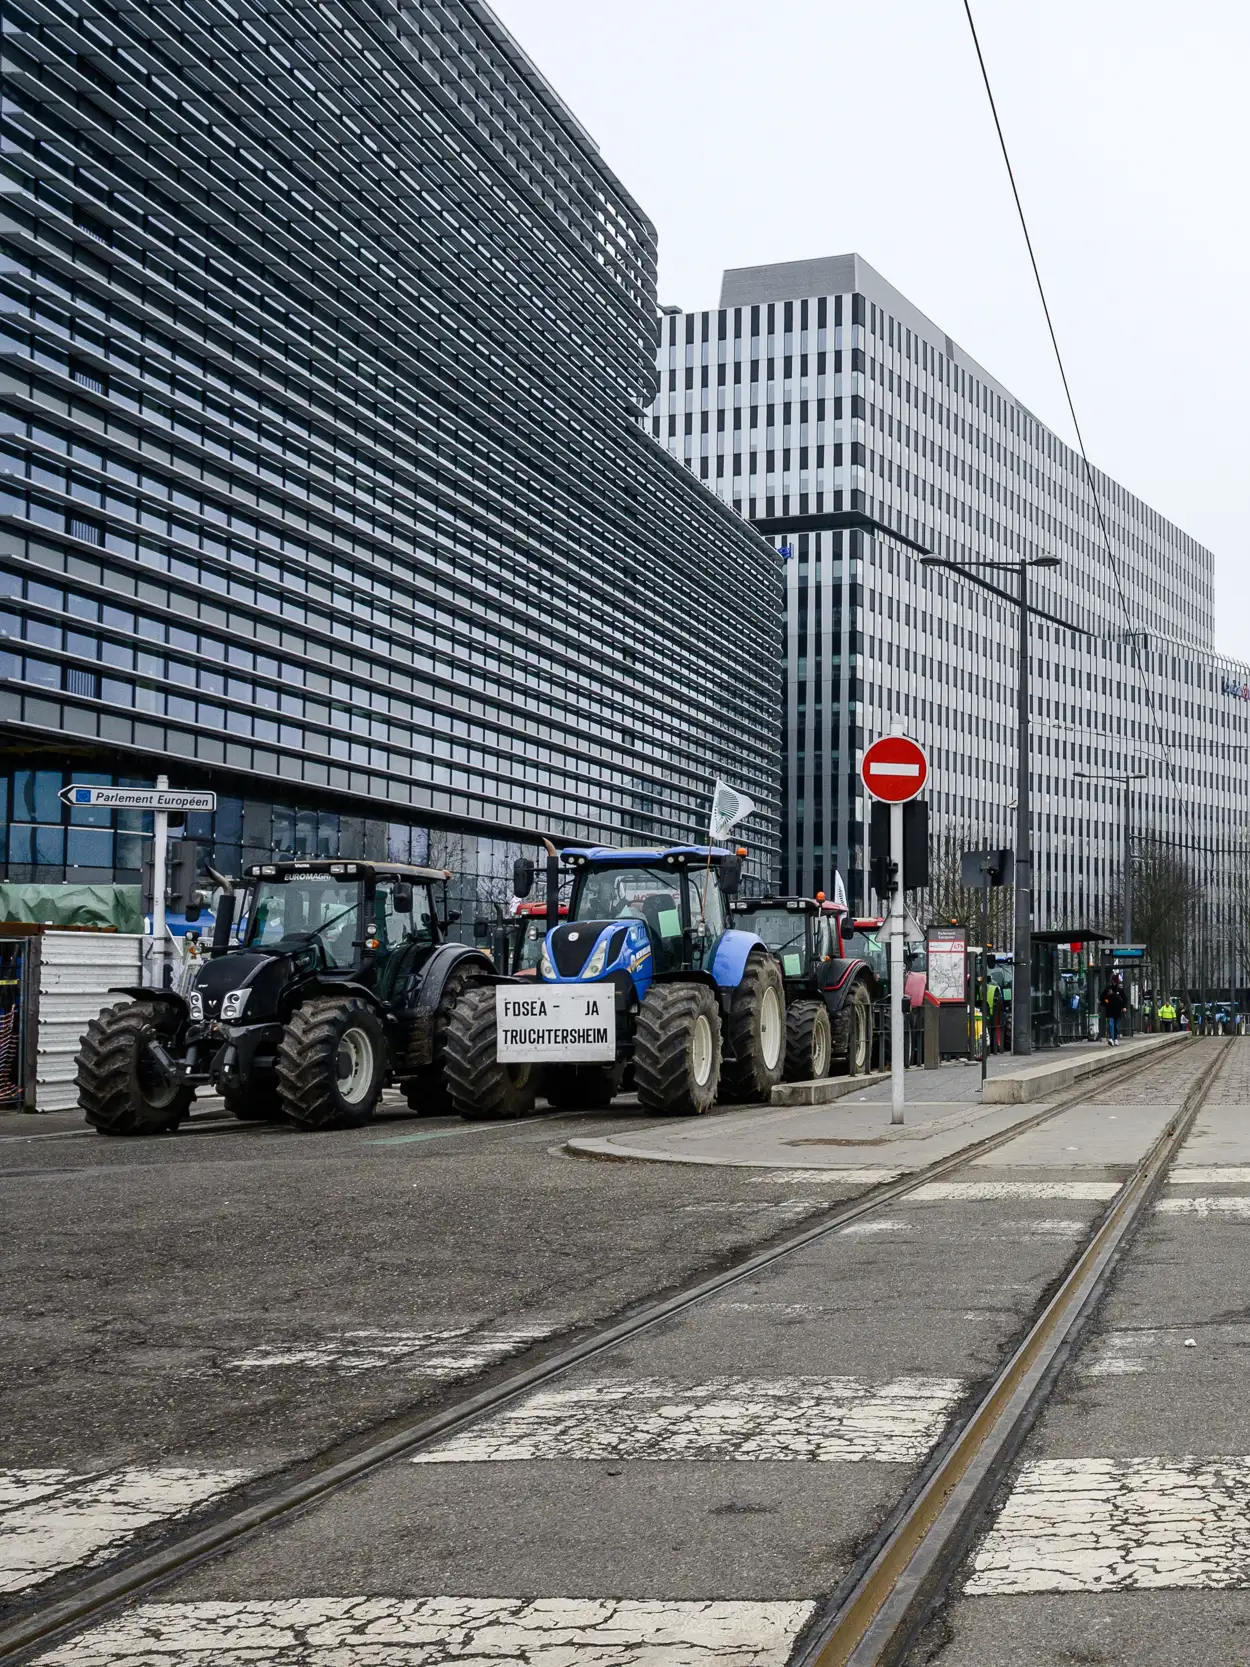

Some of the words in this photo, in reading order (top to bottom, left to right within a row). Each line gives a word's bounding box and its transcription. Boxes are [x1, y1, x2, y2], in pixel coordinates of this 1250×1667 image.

[95, 791, 153, 805] Parlement
[157, 794, 209, 808] Européen
[504, 1001, 548, 1017] FDSEA
[585, 1000, 600, 1016] JA
[502, 1028, 608, 1045] TRUCHTERSHEIM
